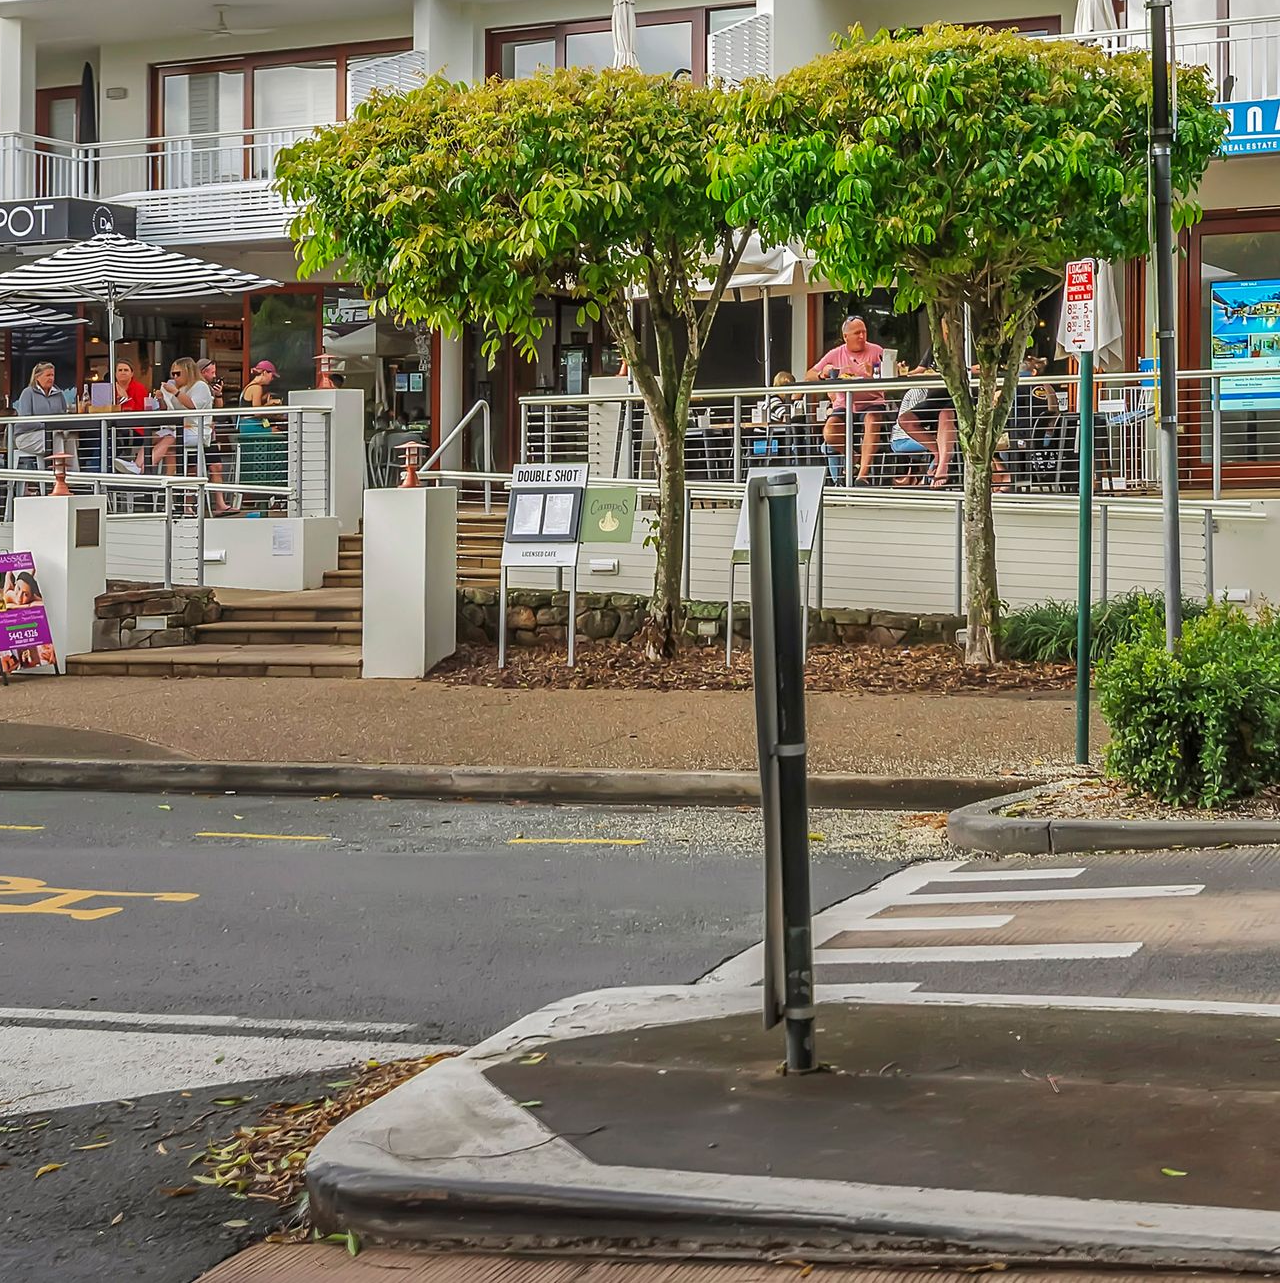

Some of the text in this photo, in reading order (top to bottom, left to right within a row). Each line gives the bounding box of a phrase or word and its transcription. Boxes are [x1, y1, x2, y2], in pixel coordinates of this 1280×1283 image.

[1222, 141, 1278, 152] REAL ESTATE
[1069, 263, 1091, 274] LOADING
[1071, 273, 1089, 284] ZONE
[517, 469, 553, 483] DOUBLE
[554, 469, 579, 482] SHOT
[521, 550, 557, 558] LICENSED CAFE
[9, 631, 23, 641] 5442
[25, 629, 38, 638] 4326
